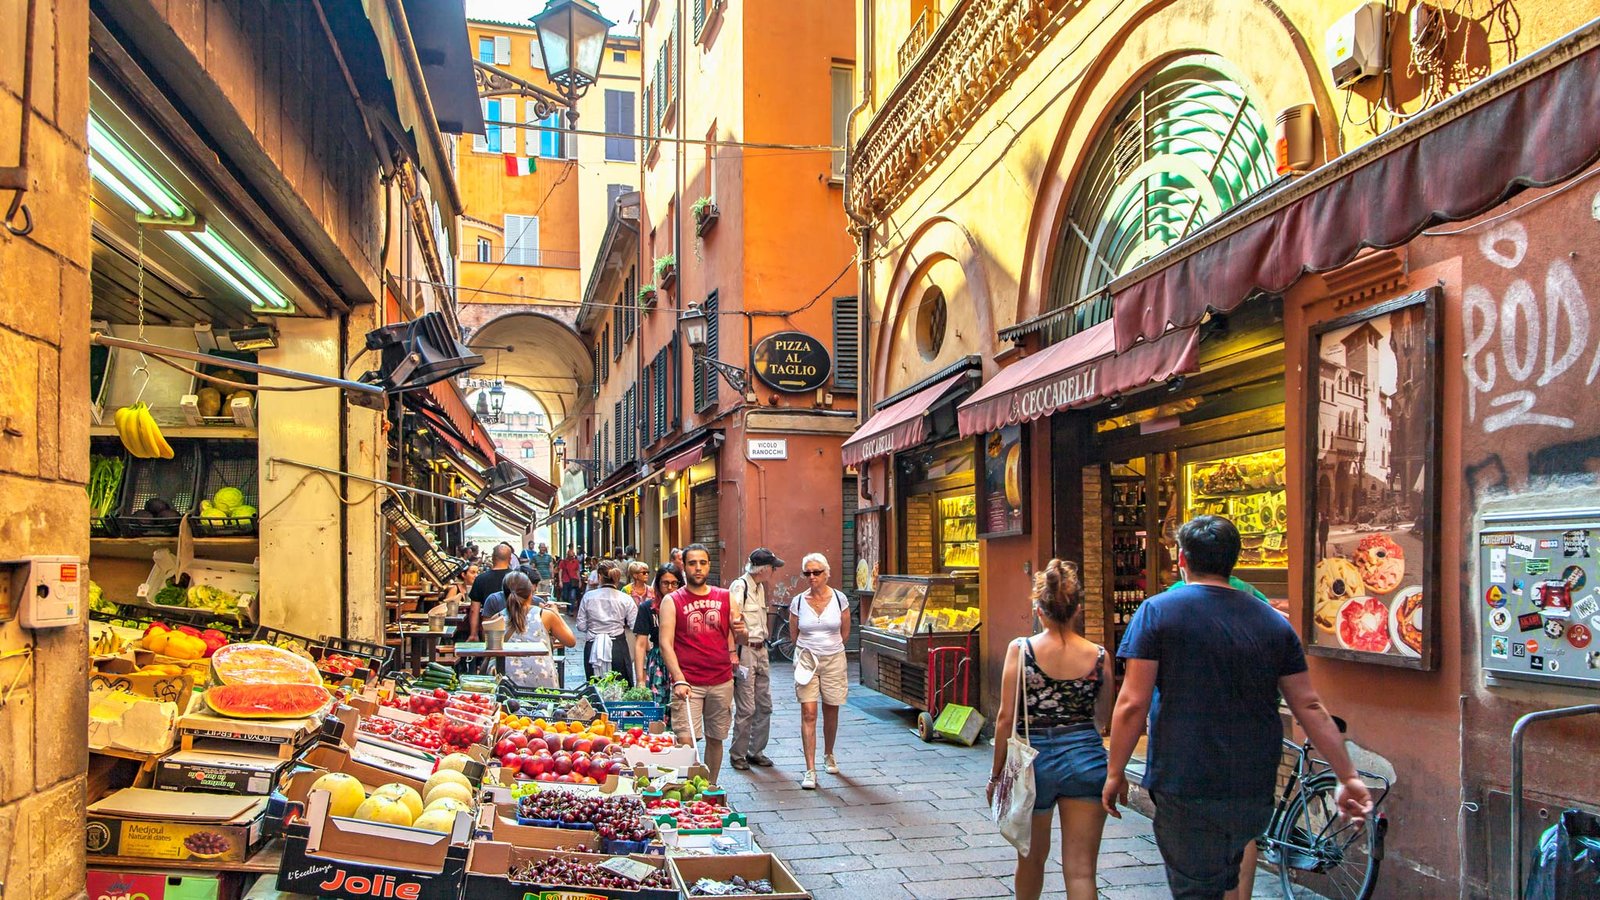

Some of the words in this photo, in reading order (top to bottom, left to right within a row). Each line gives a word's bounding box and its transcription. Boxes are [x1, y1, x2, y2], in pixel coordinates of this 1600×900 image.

[775, 340, 811, 352] PIZZA
[785, 353, 802, 363] AL
[769, 364, 817, 376] TAGLIO
[1021, 368, 1097, 416] CECCARELLI
[862, 432, 894, 459] CECCARELLI
[129, 825, 164, 835] Medjoul
[153, 834, 172, 842] dates
[287, 863, 334, 881] l'Eccellenza
[319, 869, 422, 900] Jolie
